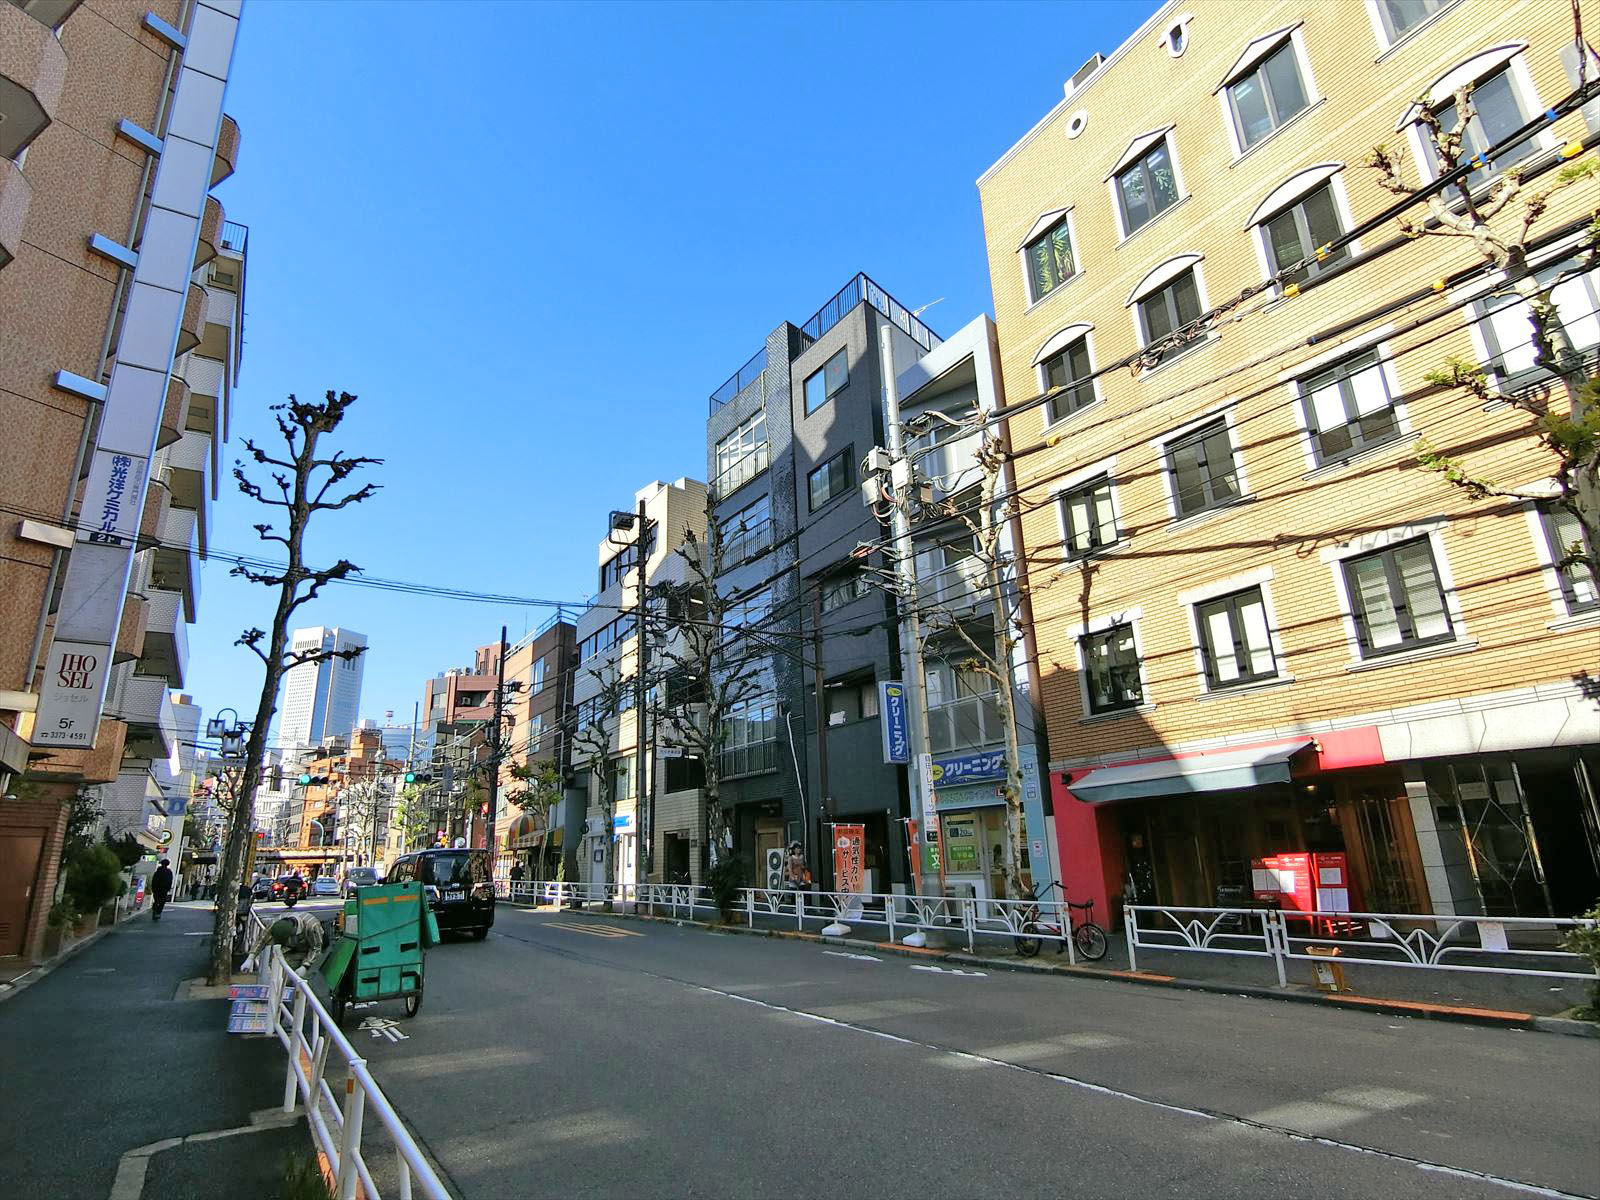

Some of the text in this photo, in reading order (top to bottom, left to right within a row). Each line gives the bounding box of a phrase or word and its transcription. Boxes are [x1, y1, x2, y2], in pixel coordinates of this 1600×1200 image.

[57, 670, 94, 689] SEL
[58, 717, 75, 729] 5F
[890, 697, 905, 755] クリーニング
[945, 754, 1004, 777] クリーニング
[841, 849, 850, 902] サービス中
[851, 837, 860, 893] 通気性カバー
